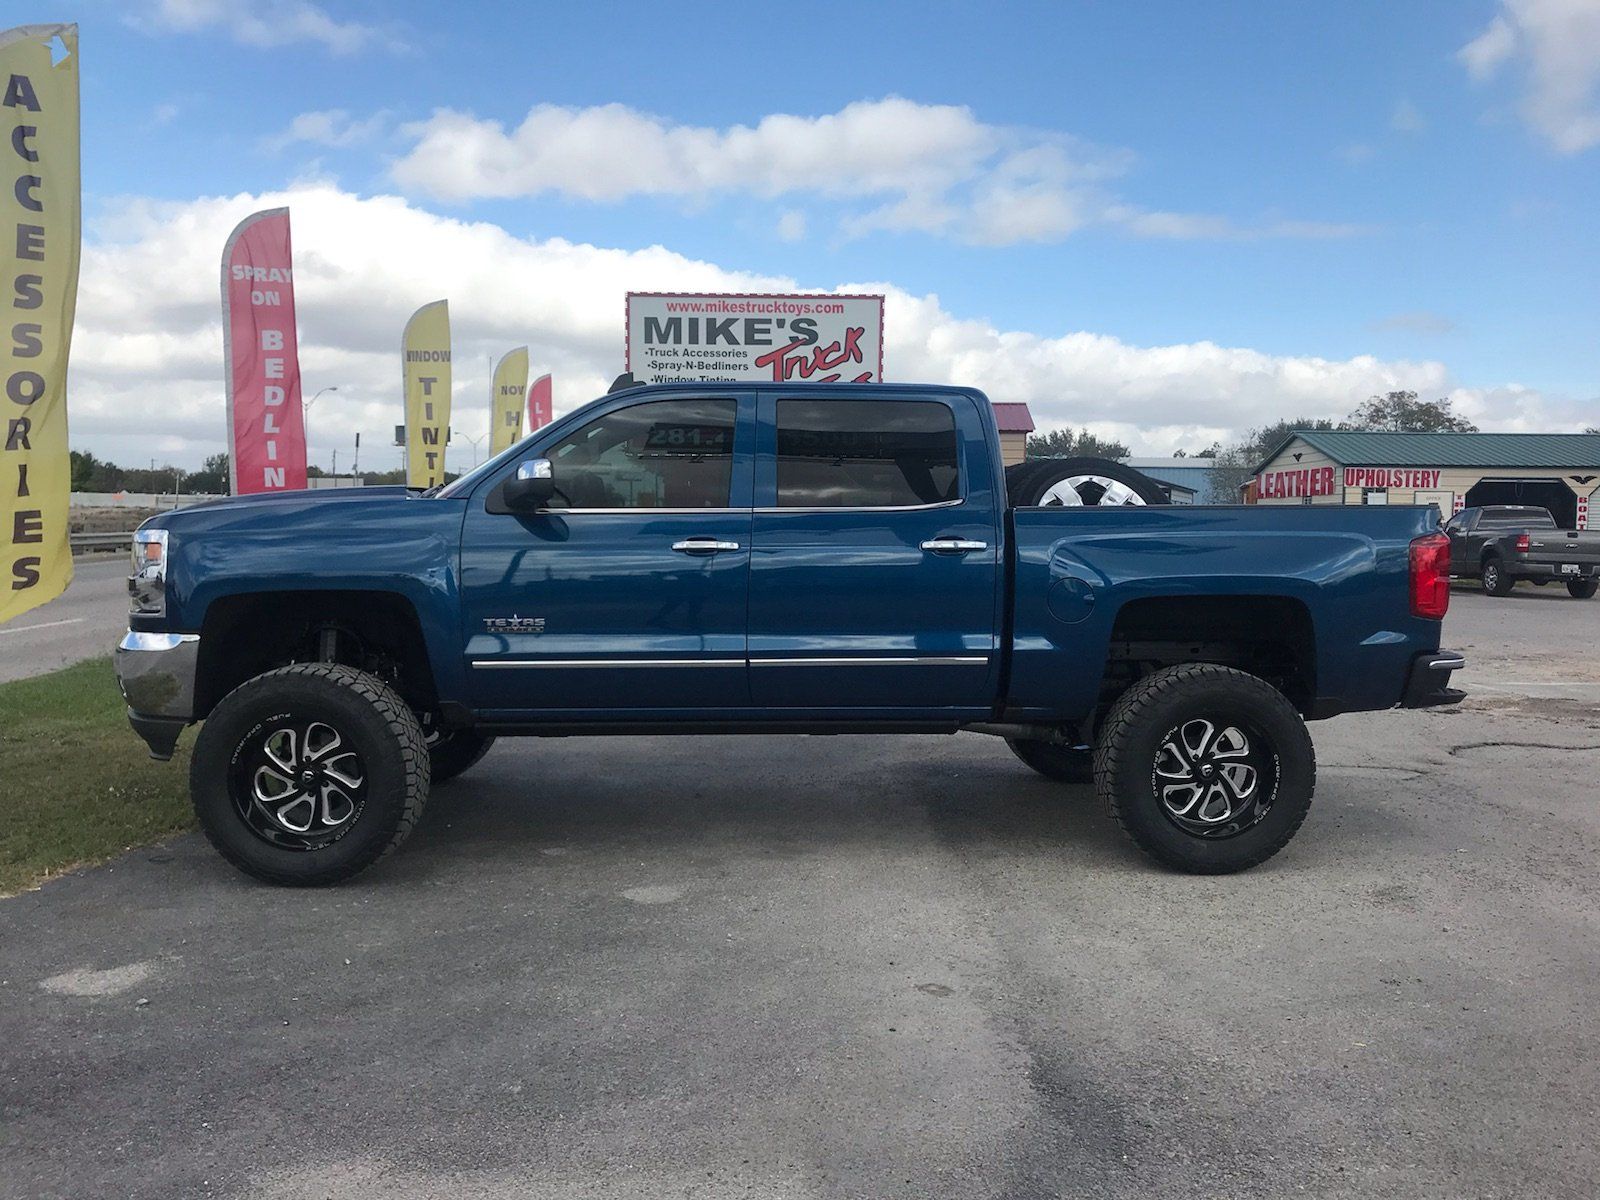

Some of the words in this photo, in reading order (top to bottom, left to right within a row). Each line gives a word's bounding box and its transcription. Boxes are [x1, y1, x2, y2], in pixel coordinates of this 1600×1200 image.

[232, 264, 291, 283] SPRAY
[252, 291, 280, 306] ON
[666, 300, 844, 316] www.mikestrucktoys.com
[3, 74, 45, 590] ACCESSORIES
[644, 317, 819, 346] MIKE'S
[648, 348, 679, 357] Truck
[682, 348, 748, 358] Accessories
[651, 360, 749, 371] Spray-N-Bedliners
[261, 330, 285, 488] BEDLIN
[1256, 467, 1335, 499] LEATHER
[1345, 468, 1441, 488] UPHOLSTERY
